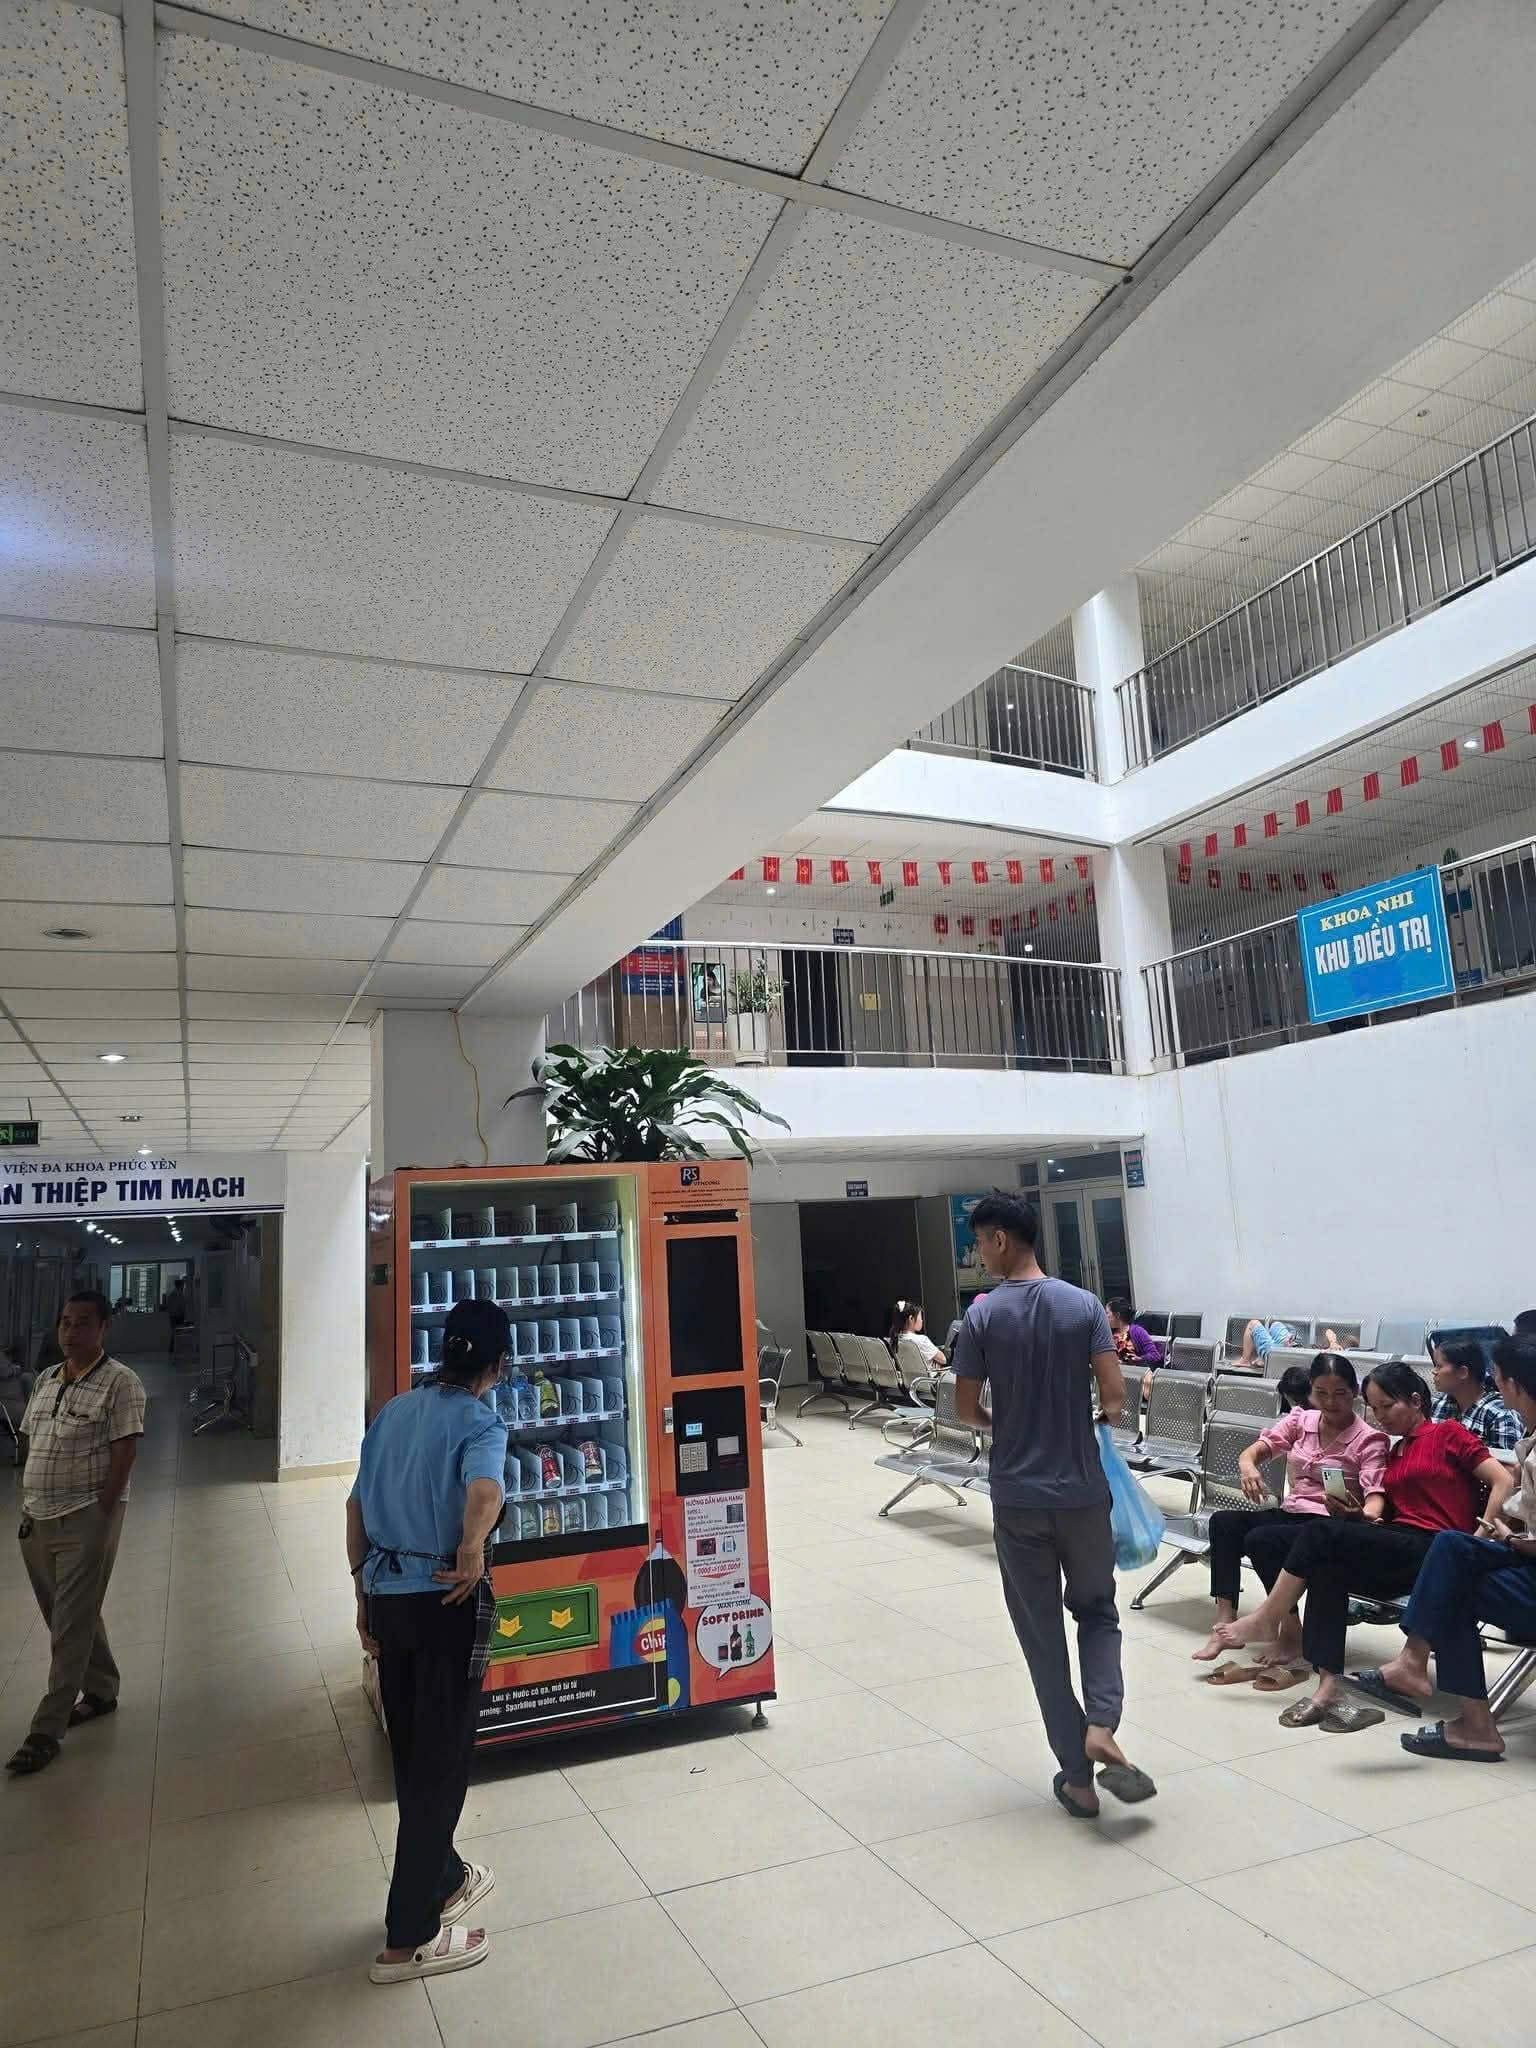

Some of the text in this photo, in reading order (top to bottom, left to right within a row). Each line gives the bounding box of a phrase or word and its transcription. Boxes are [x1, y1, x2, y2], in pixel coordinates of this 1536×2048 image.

[1320, 890, 1414, 931] KHOA NHI
[1314, 914, 1432, 975] KHU ĐIỀU TRỊ
[3, 1158, 177, 1176] VIỆN ĐA KHOA PHÚC YÊN
[0, 1176, 245, 1207] N THIỆP TIM MẠCH
[702, 1608, 764, 1626] SOFT DRINK
[479, 1706, 502, 1717] arning:
[505, 1701, 537, 1713] Sparkling
[558, 1693, 574, 1703] open
[575, 1688, 596, 1699] slowly
